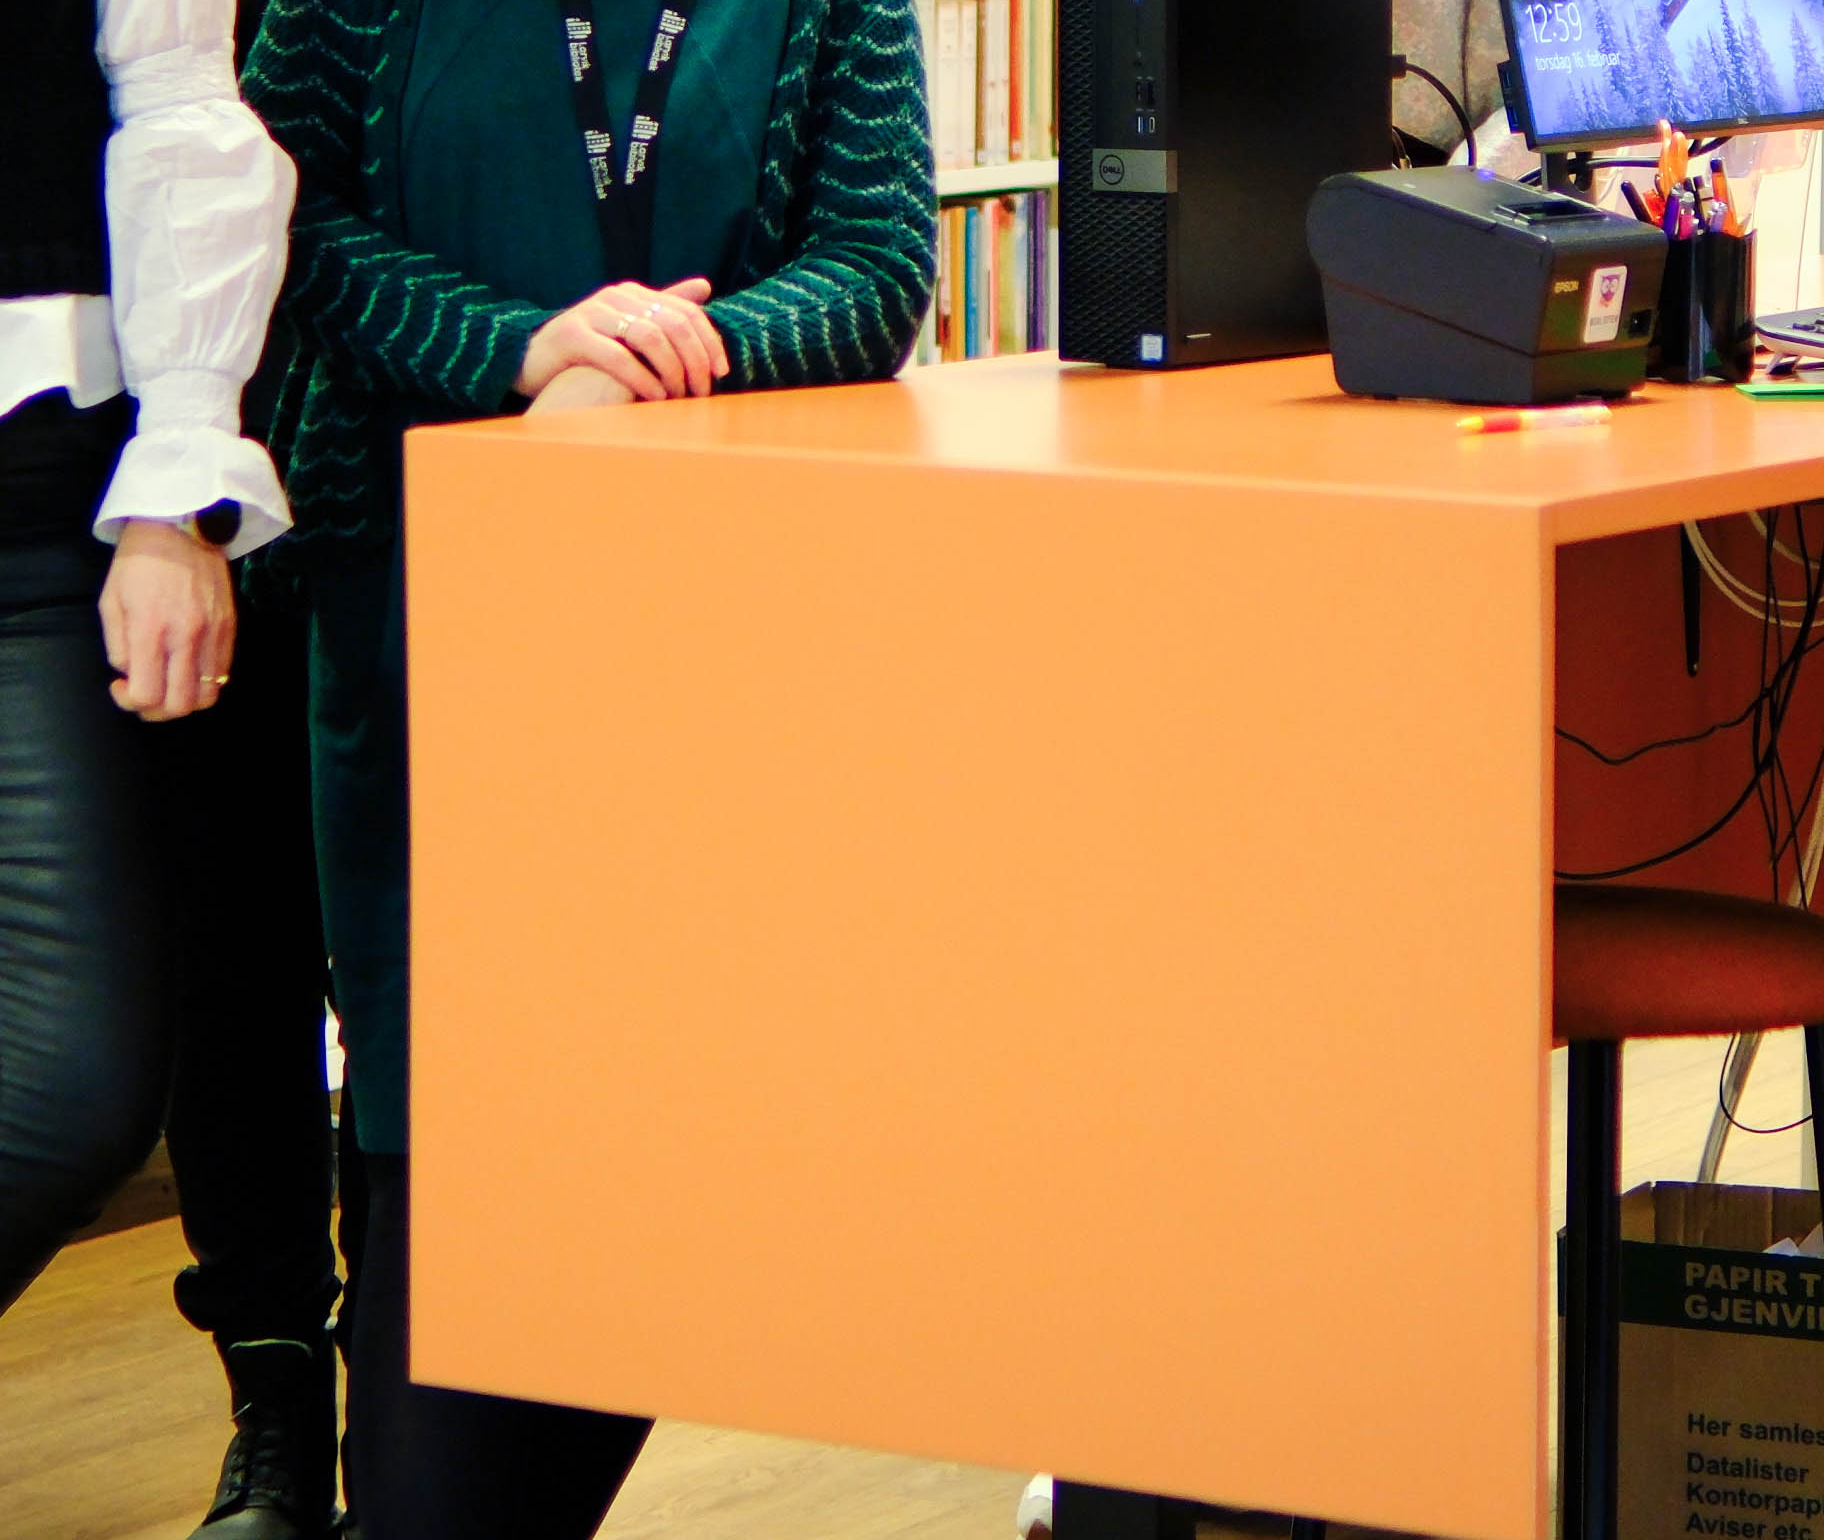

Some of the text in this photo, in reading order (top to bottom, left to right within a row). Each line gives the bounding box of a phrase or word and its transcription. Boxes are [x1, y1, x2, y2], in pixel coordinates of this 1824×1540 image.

[1524, 1, 1583, 43] 12:59
[1535, 52, 1573, 74] torsdag
[1587, 50, 1621, 68] februar
[1102, 166, 1121, 175] DELL
[1685, 1261, 1788, 1297] PAPIR
[1687, 1413, 1730, 1438] Her
[1687, 1453, 1810, 1485] Datalister
[1685, 1512, 1767, 1539] Aviser
